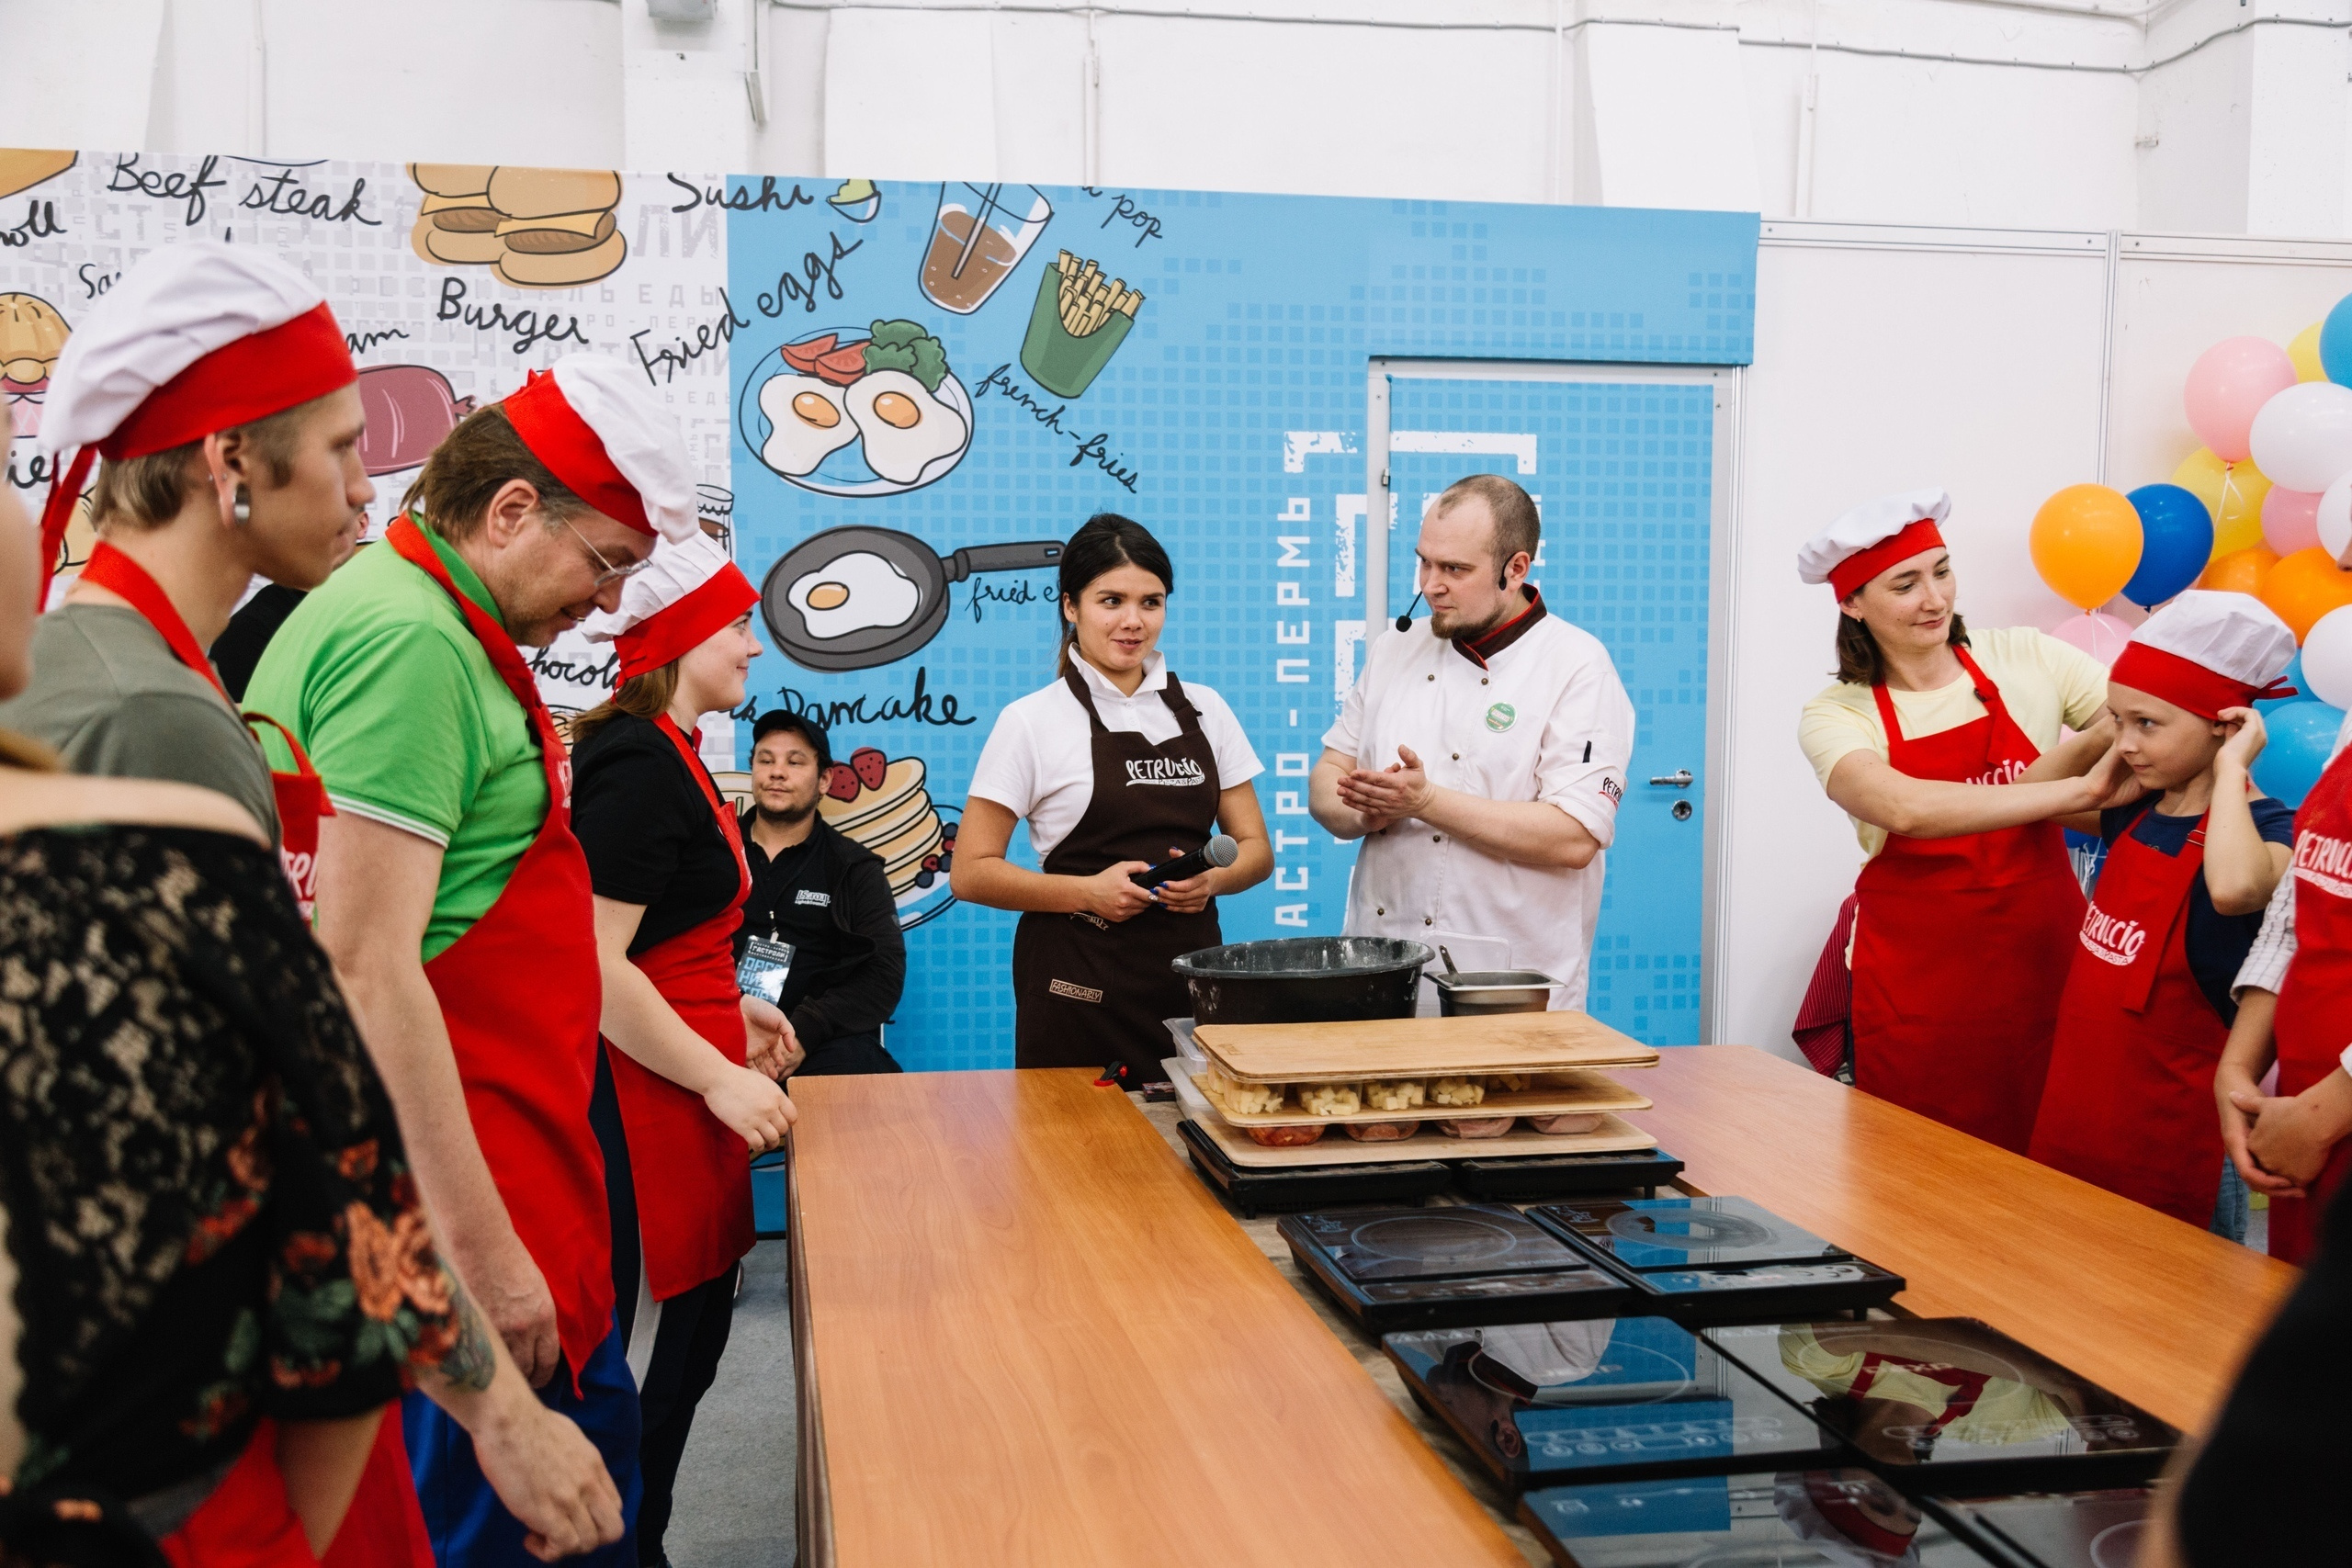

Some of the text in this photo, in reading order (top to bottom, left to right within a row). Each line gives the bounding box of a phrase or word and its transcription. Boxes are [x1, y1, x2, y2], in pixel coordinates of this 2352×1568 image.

[107, 152, 226, 226] Beef
[239, 168, 382, 226] steak
[1101, 193, 1163, 248] pop
[78, 263, 122, 299] Sa
[630, 231, 864, 387] Fried eggs
[437, 276, 590, 355] Burger
[974, 363, 1138, 494] french-fries
[6, 450, 53, 490] ie
[965, 577, 1037, 624] fried
[777, 666, 978, 732] Pancake
[1274, 497, 1311, 928] АСТРО-ПЕРМЬ
[1052, 981, 1101, 1000] FASHIONABLY
